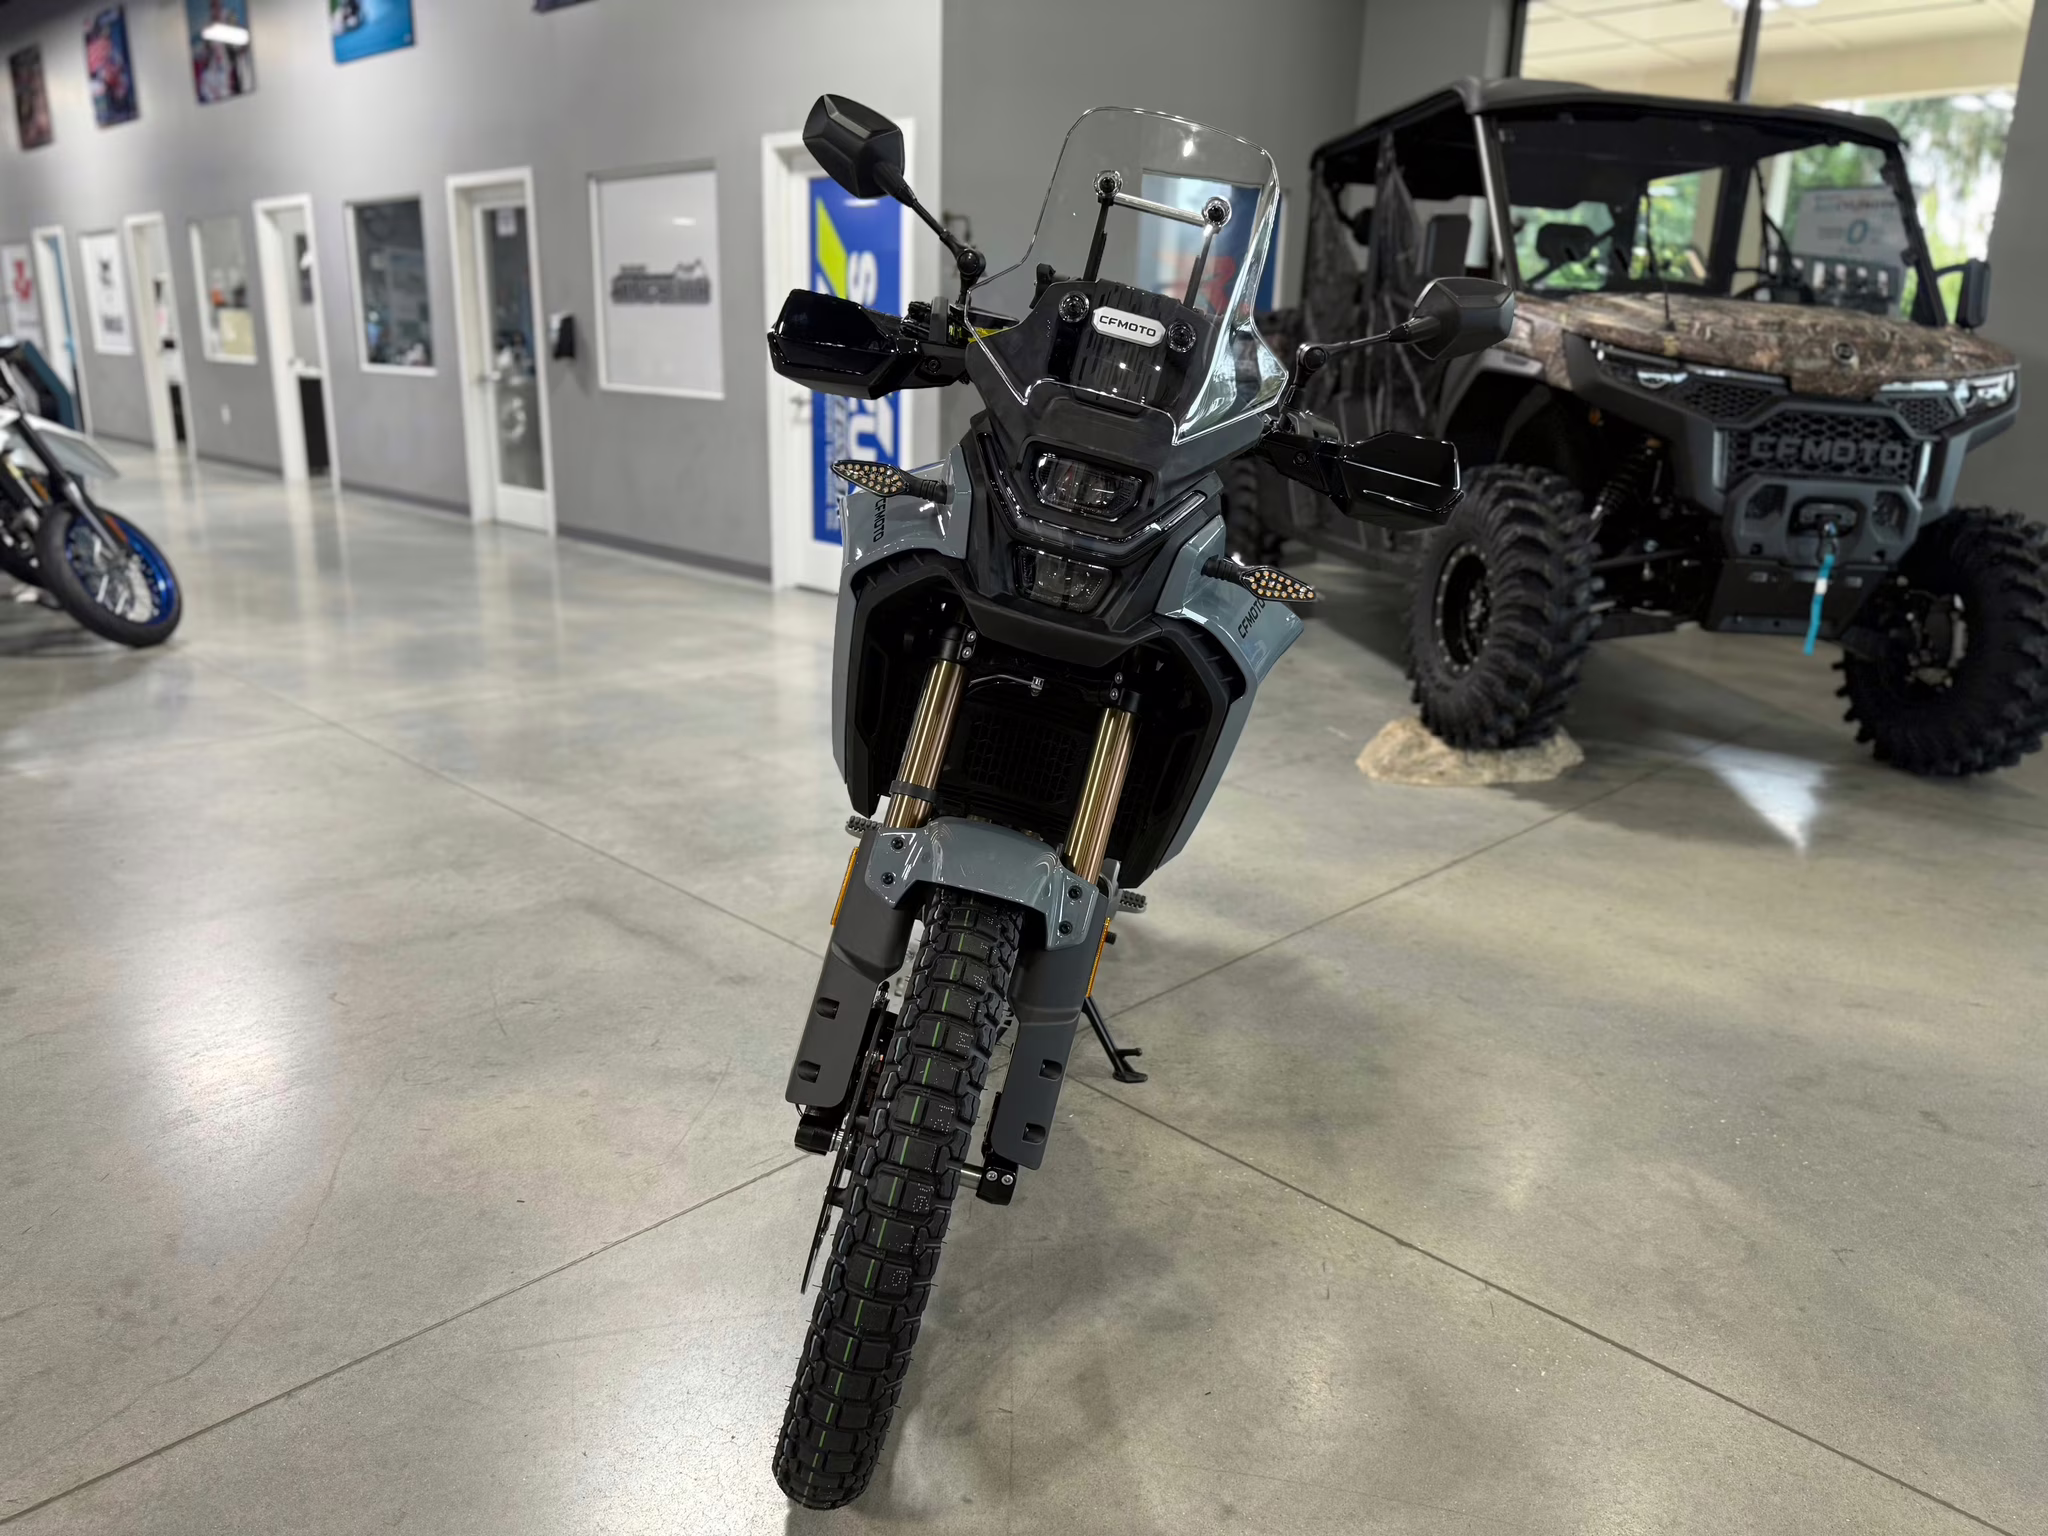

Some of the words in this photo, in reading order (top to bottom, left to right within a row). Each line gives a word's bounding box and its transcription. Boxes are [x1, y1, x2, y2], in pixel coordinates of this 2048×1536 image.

[1099, 315, 1157, 337] CFMOTO
[1751, 434, 1905, 467] CFMOTO
[872, 497, 887, 543] CFMOTO
[1237, 599, 1266, 639] CFMOTO
